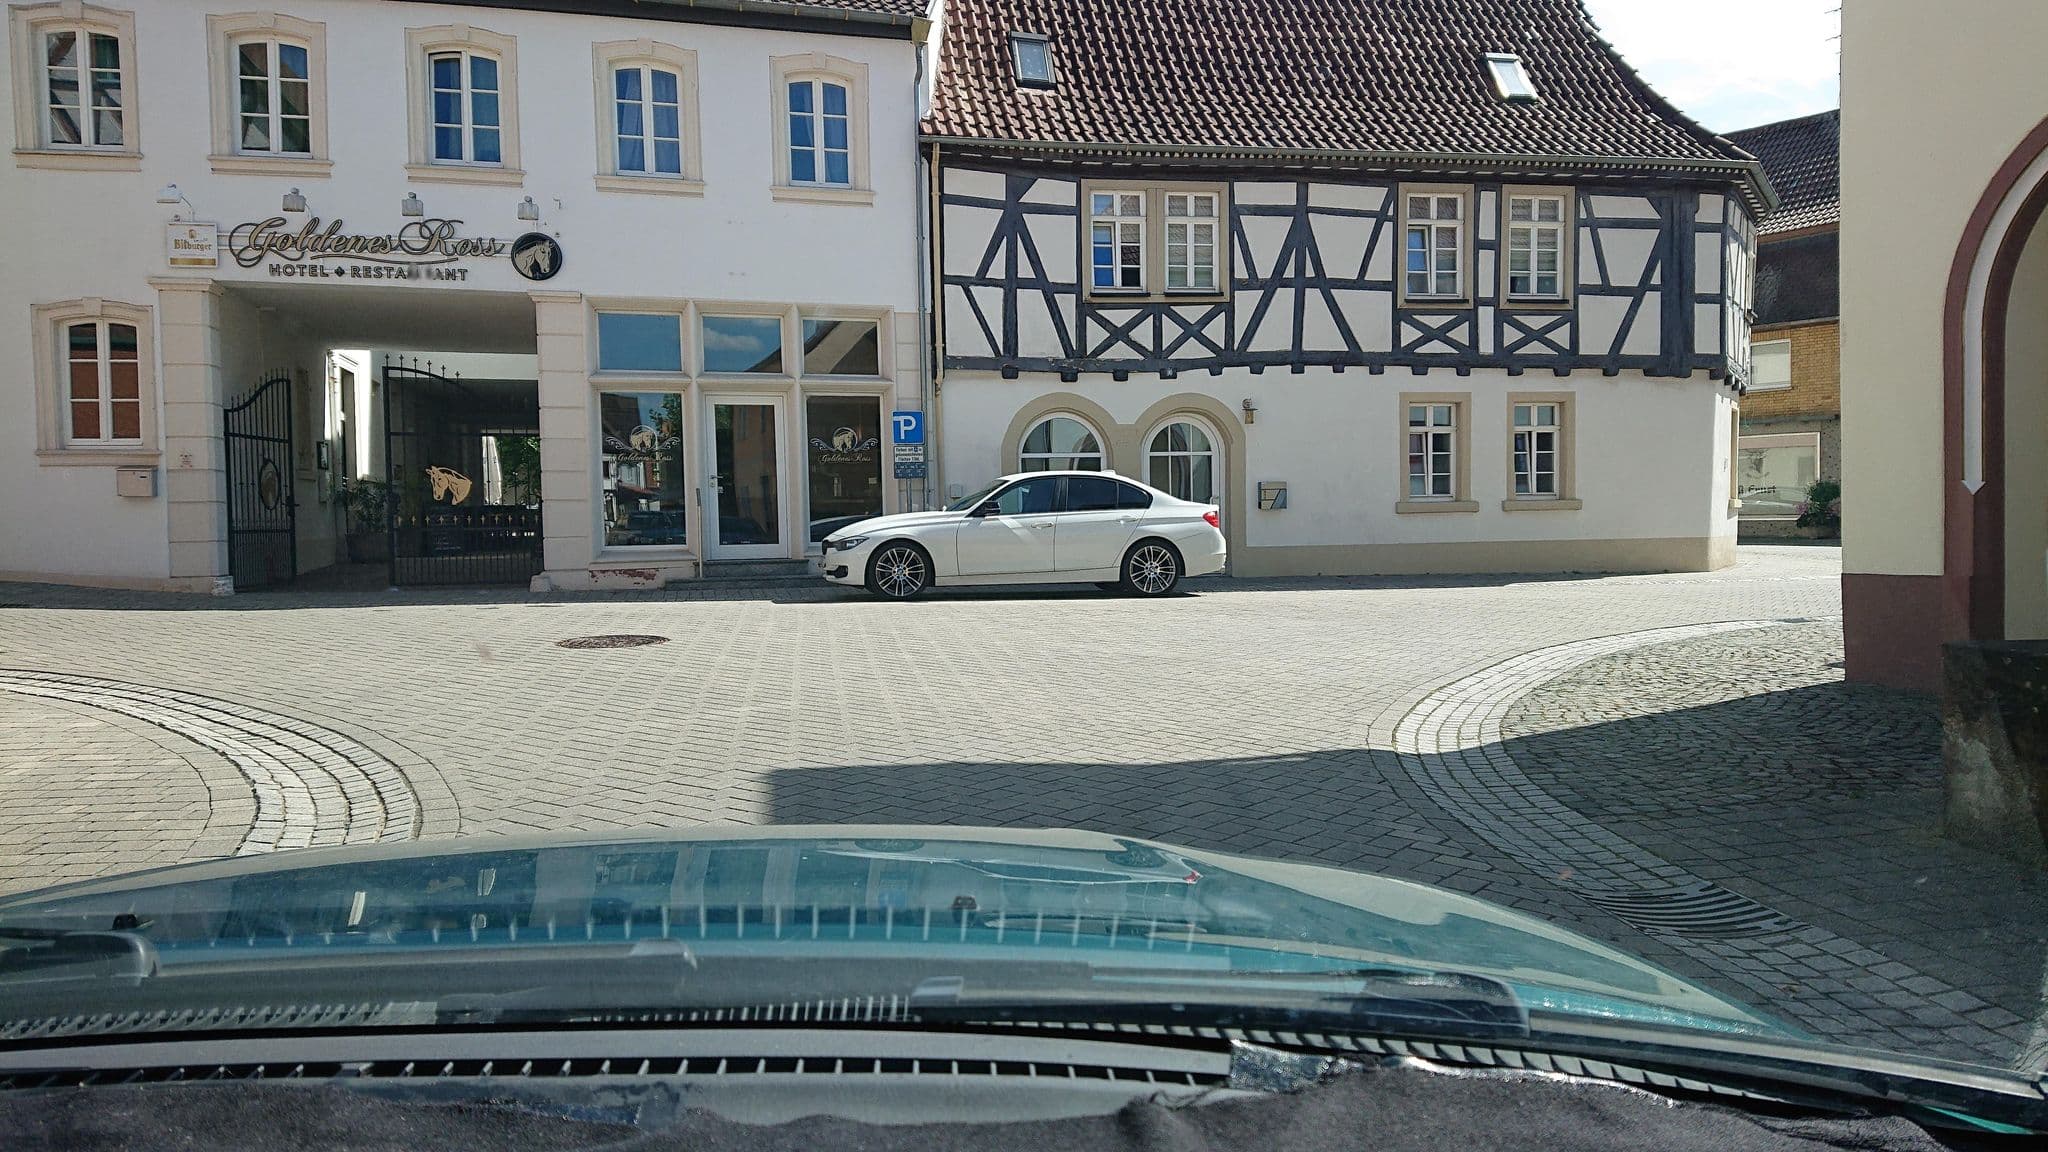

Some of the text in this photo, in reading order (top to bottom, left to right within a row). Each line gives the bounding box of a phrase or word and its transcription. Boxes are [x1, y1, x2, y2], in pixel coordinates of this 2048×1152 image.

[174, 239, 212, 251] Bitburger
[229, 216, 506, 268] Goldenes Ross
[269, 263, 468, 281] HOTEL RESTAANT
[898, 415, 917, 440] P
